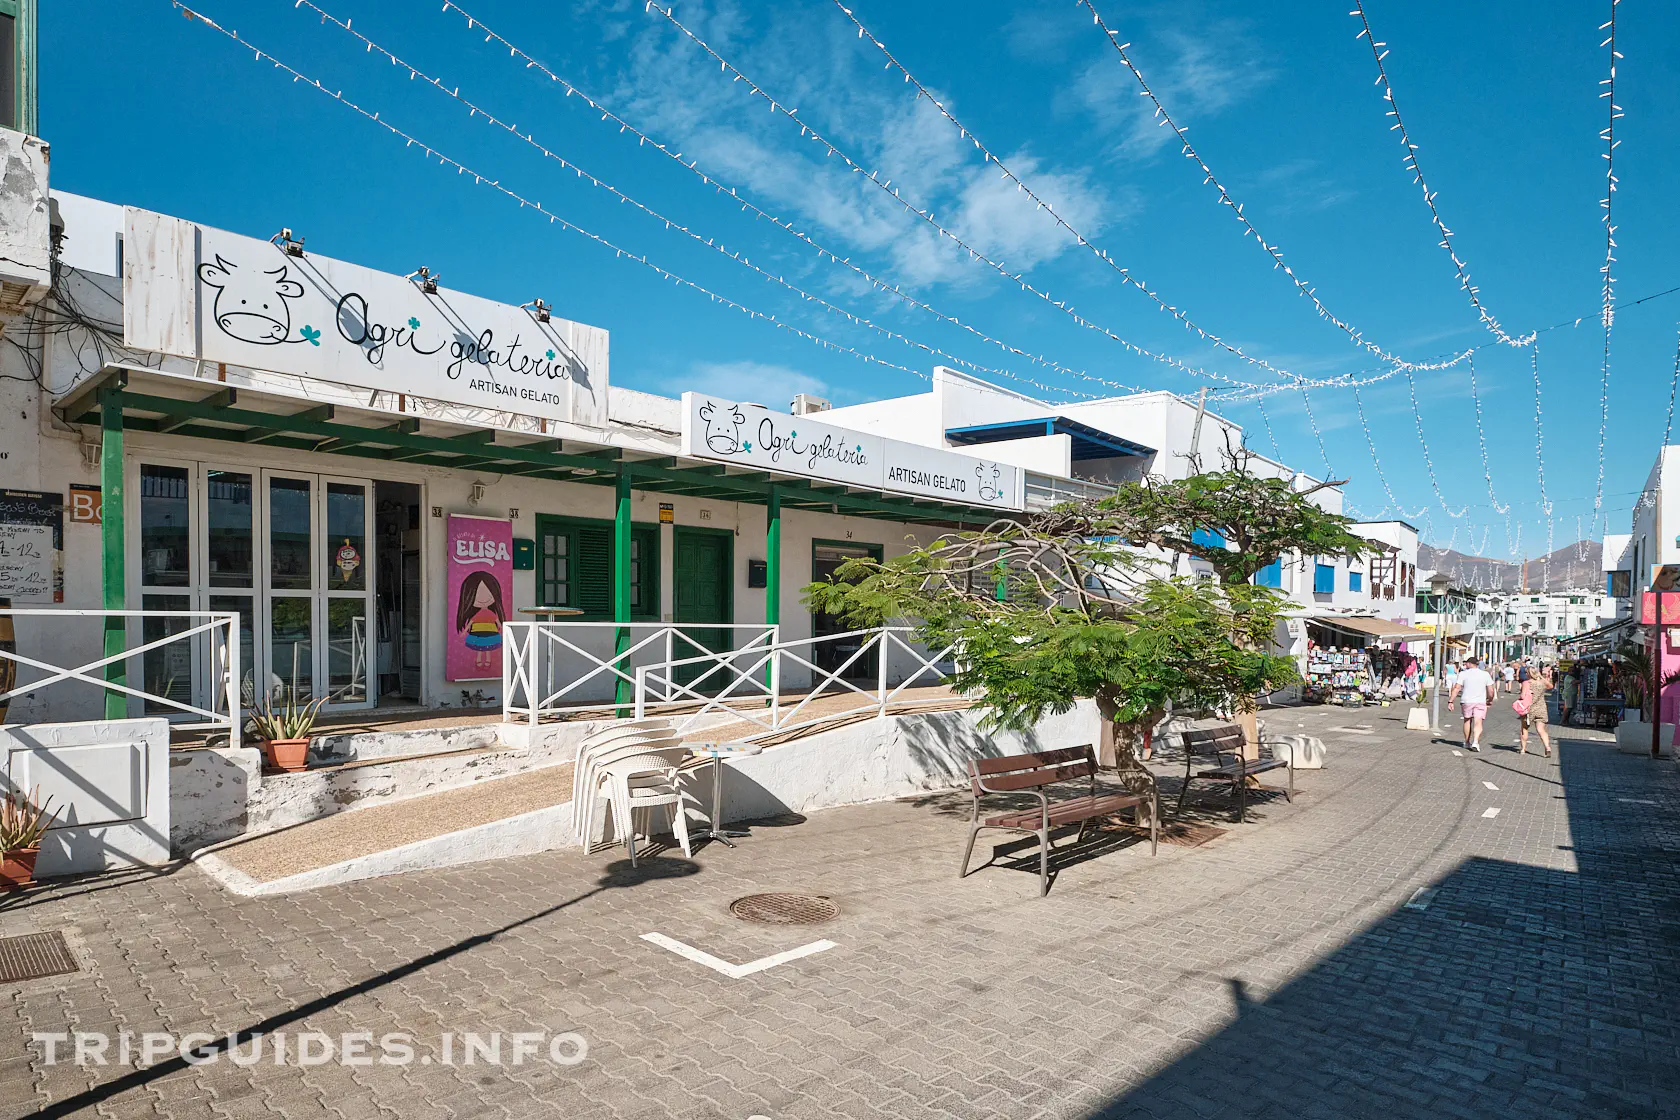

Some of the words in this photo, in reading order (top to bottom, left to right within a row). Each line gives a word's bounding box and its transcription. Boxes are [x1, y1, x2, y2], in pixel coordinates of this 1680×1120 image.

[336, 292, 446, 365] Agri
[446, 328, 570, 380] gelateria
[469, 378, 517, 398] ARTISAN
[520, 388, 560, 405] GELATO
[758, 417, 809, 463] Agri
[808, 434, 869, 470] gelateria
[888, 466, 931, 487] ARTISAN
[933, 474, 966, 493] GELATO
[845, 530, 853, 539] 34
